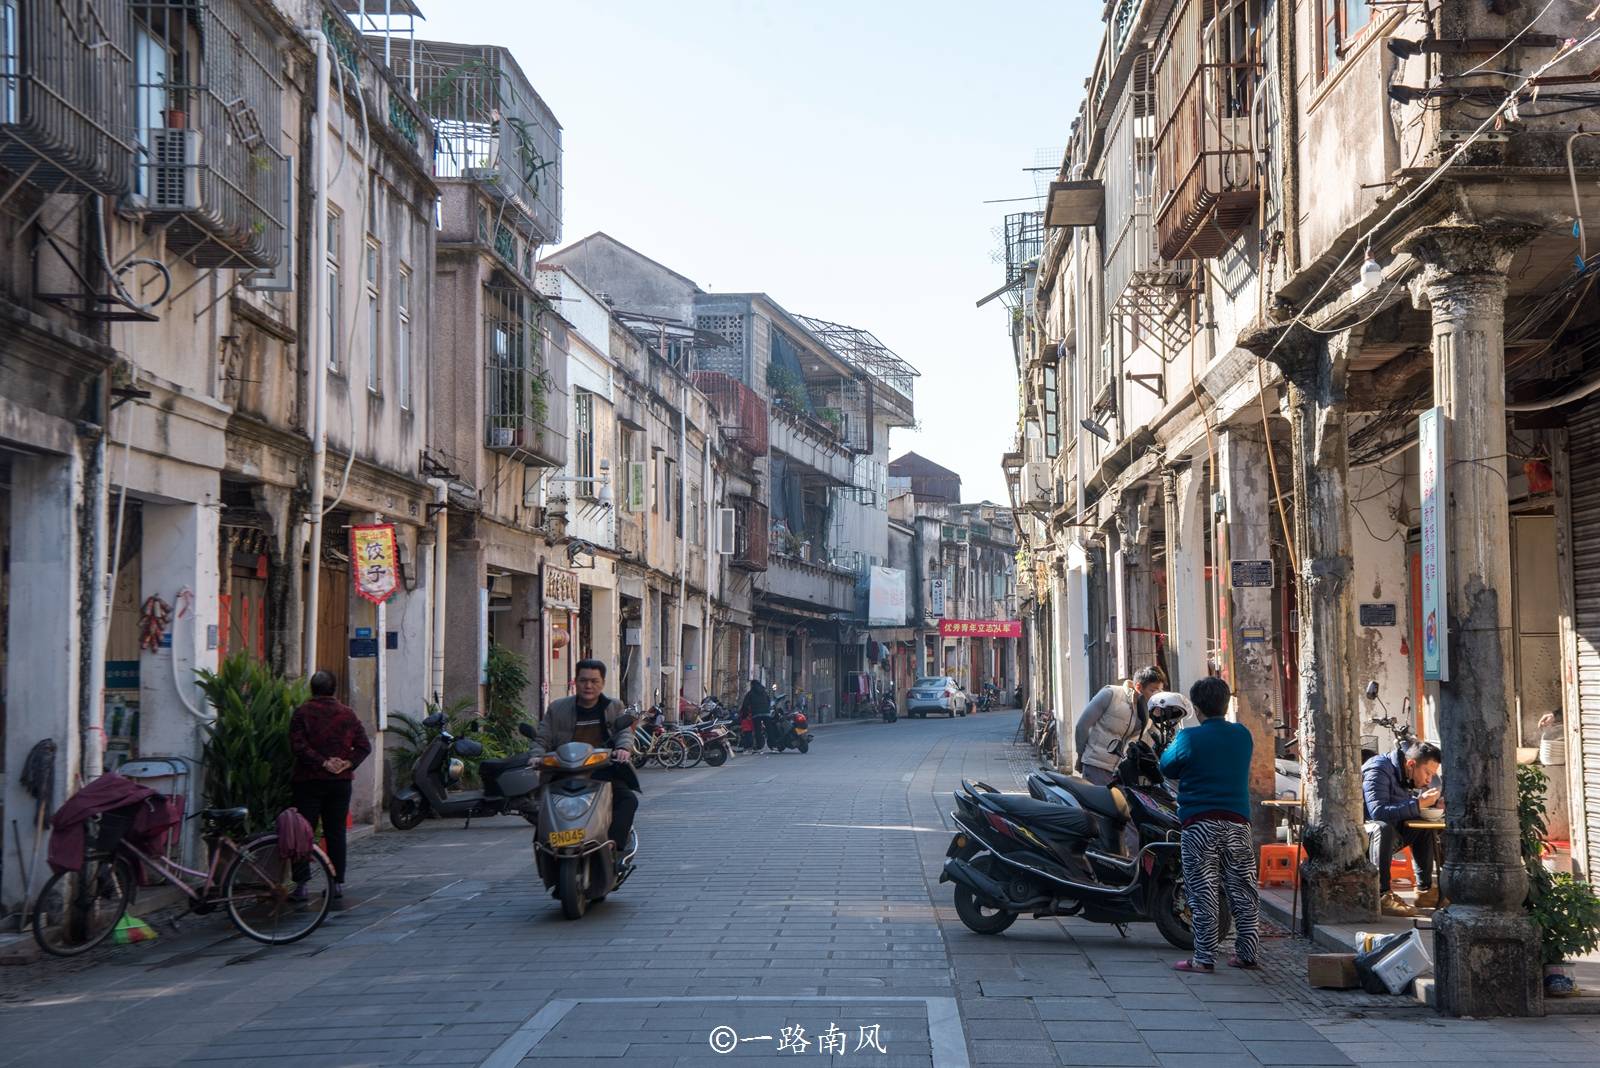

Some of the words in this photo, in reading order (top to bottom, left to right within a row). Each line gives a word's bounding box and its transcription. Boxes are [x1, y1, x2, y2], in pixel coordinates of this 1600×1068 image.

[365, 542, 386, 583] 饺子
[944, 623, 1011, 633] 优秀青年立志从军
